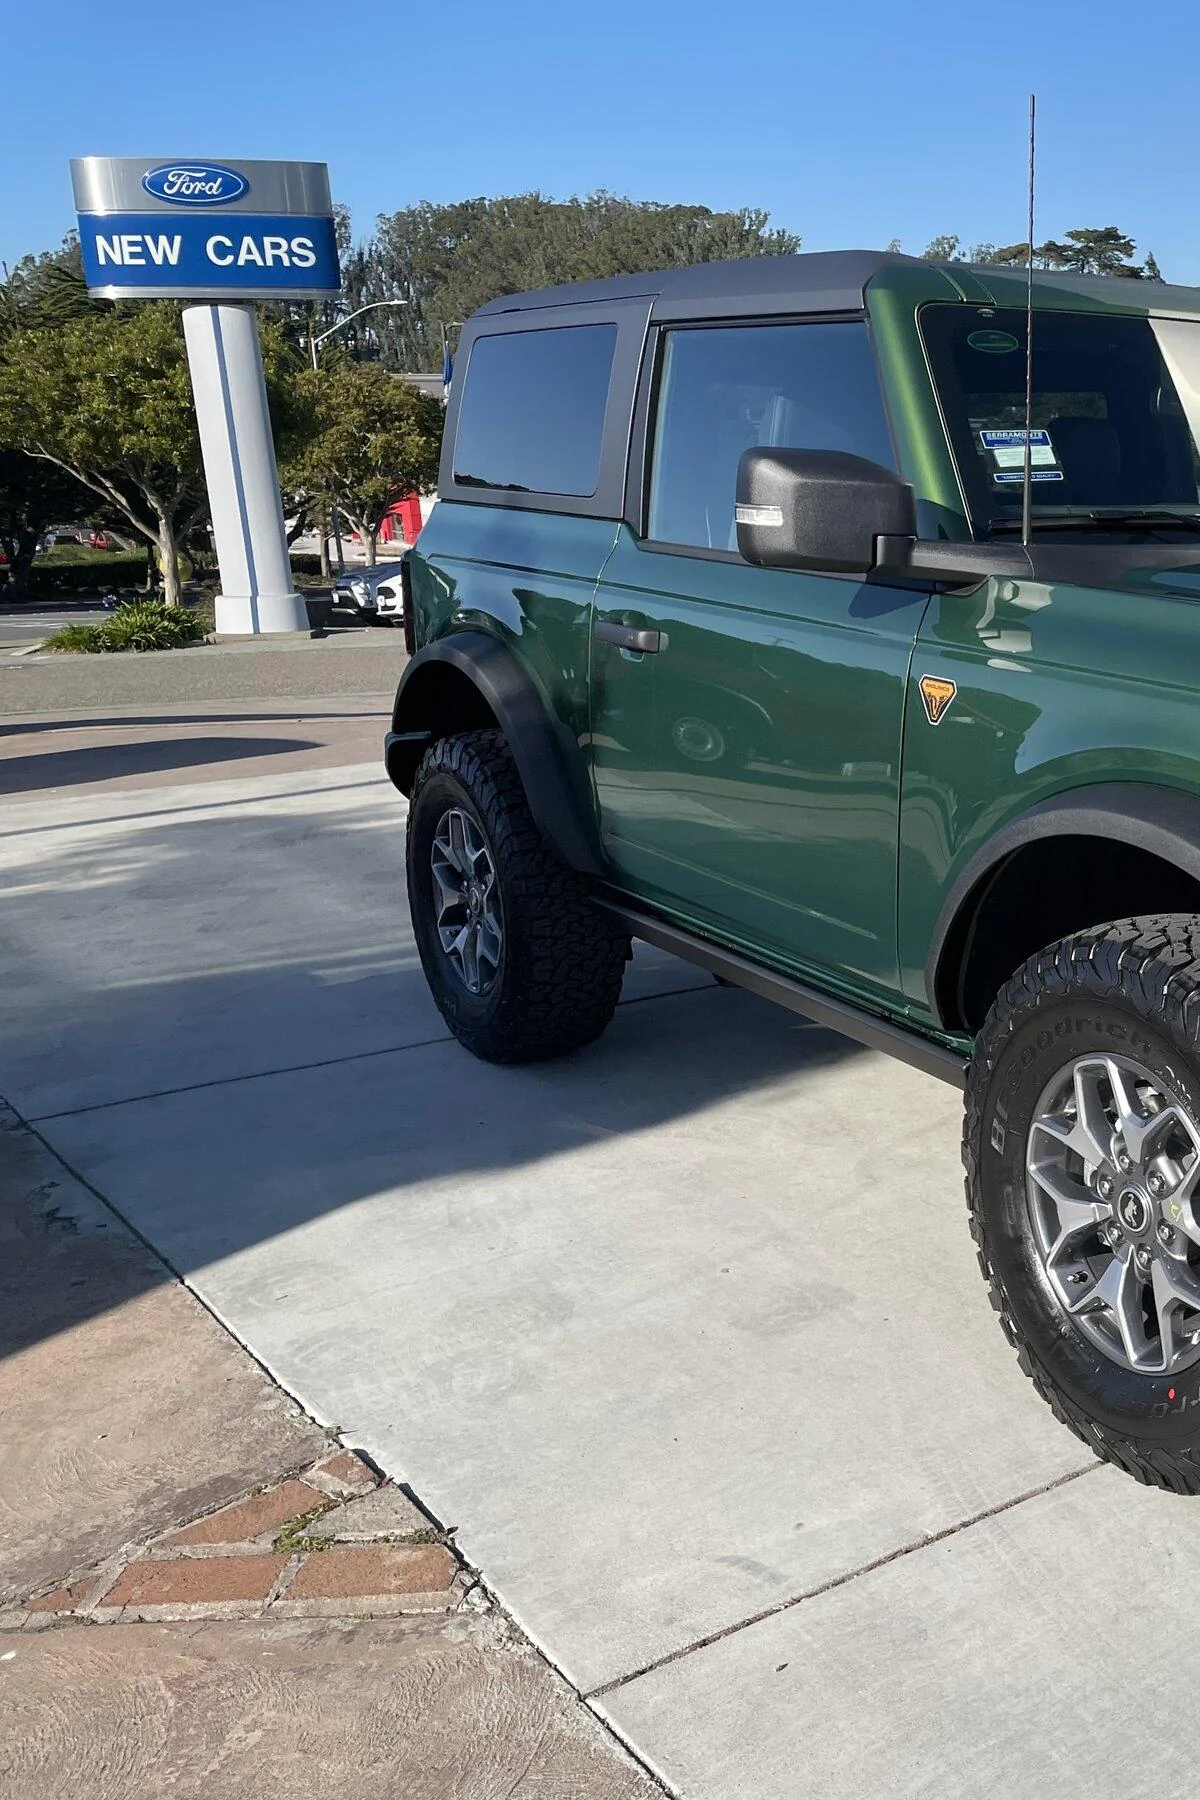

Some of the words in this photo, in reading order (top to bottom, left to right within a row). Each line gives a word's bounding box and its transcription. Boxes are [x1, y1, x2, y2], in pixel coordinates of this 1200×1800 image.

[163, 170, 223, 195] Ford
[95, 234, 182, 266] NEW
[205, 235, 317, 268] CARS
[991, 1016, 1153, 1155] BFGoodrich
